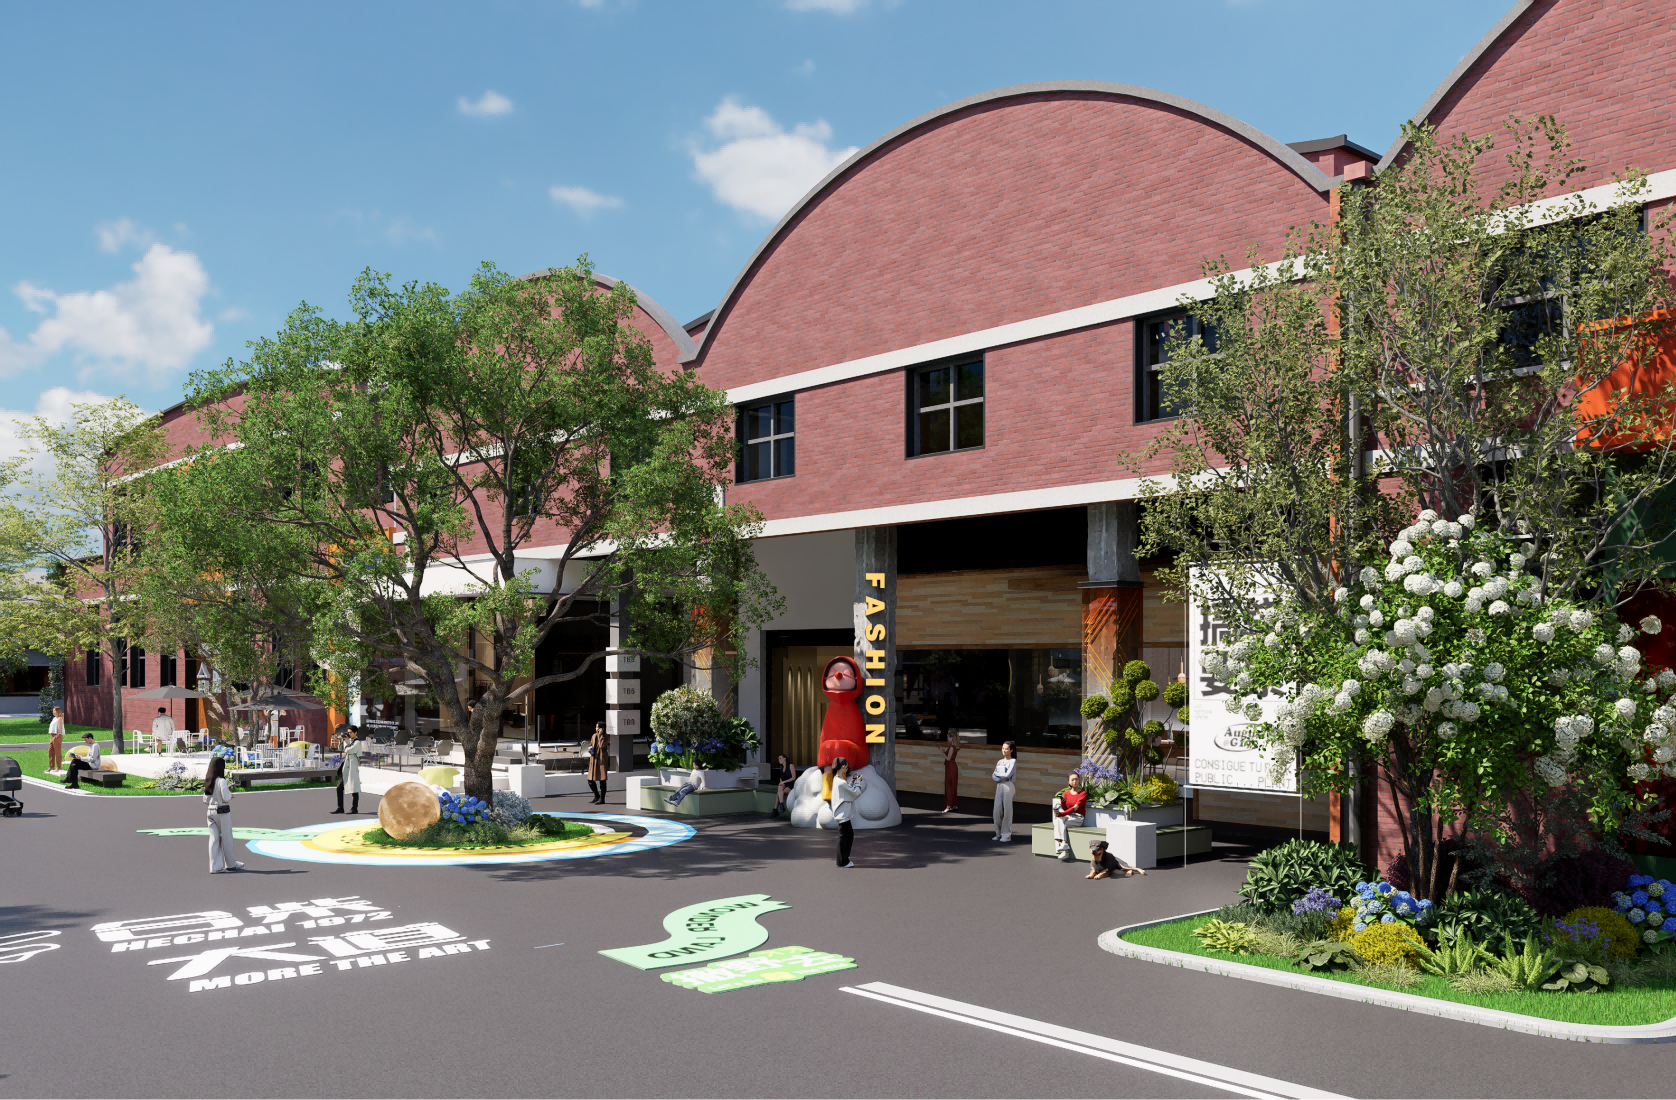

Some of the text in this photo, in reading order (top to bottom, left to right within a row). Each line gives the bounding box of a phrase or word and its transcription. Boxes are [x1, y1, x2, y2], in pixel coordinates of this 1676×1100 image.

[865, 572, 886, 744] FASHION
[1194, 758, 1246, 772] CONSIGUE
[1194, 772, 1233, 785] PUBLIC
[110, 911, 393, 953] HECHAI 1972
[188, 939, 491, 993] MORE THE ART
